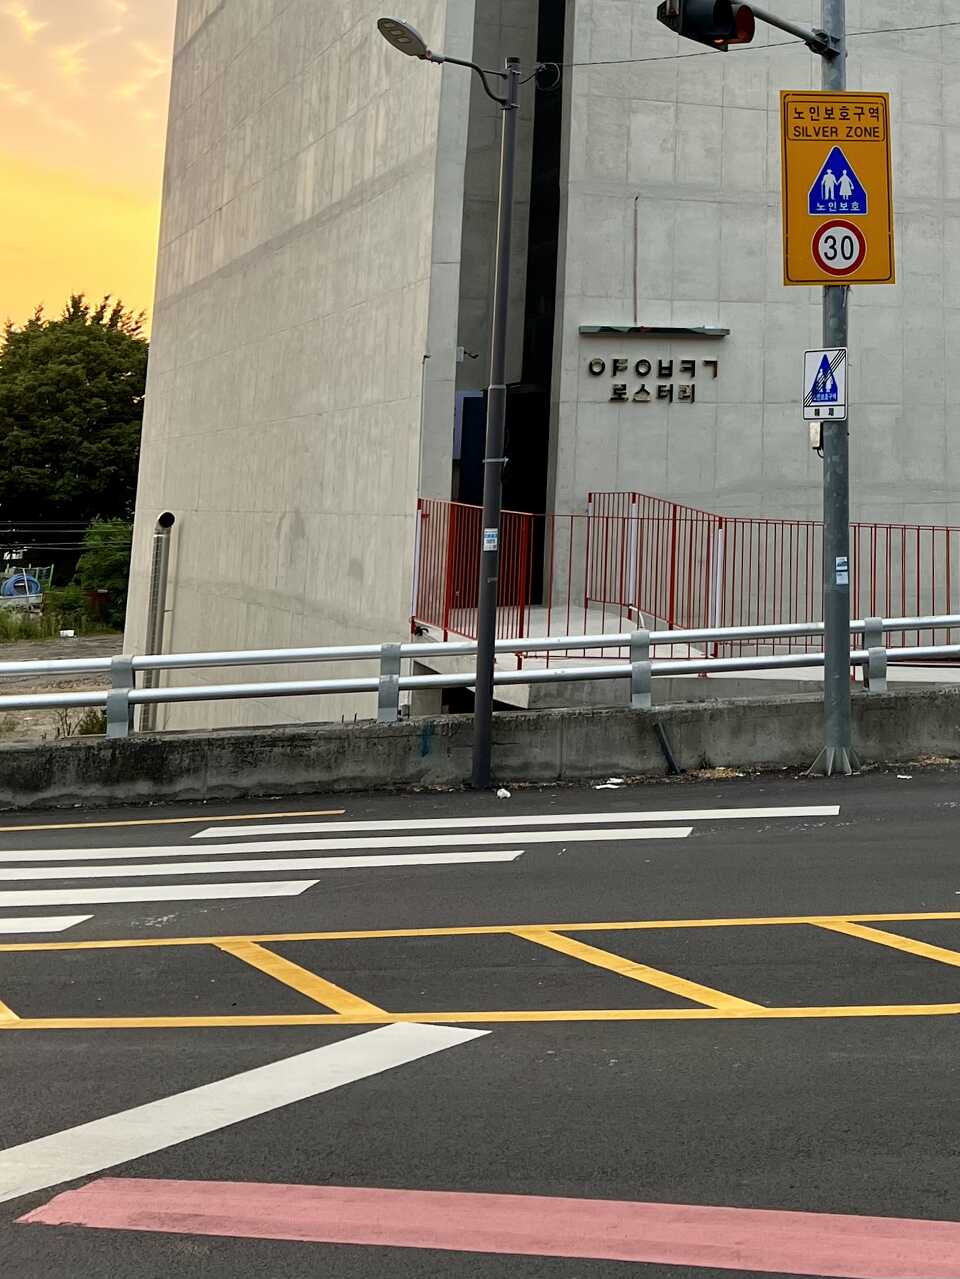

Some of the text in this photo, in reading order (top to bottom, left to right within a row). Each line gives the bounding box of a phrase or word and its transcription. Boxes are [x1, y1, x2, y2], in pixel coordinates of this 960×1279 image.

[793, 105, 880, 122] 노인보호구역
[793, 125, 880, 138] SILVER ZONE
[816, 201, 861, 212] 노인보호
[823, 235, 854, 261] 30
[609, 384, 696, 404] 로스터리
